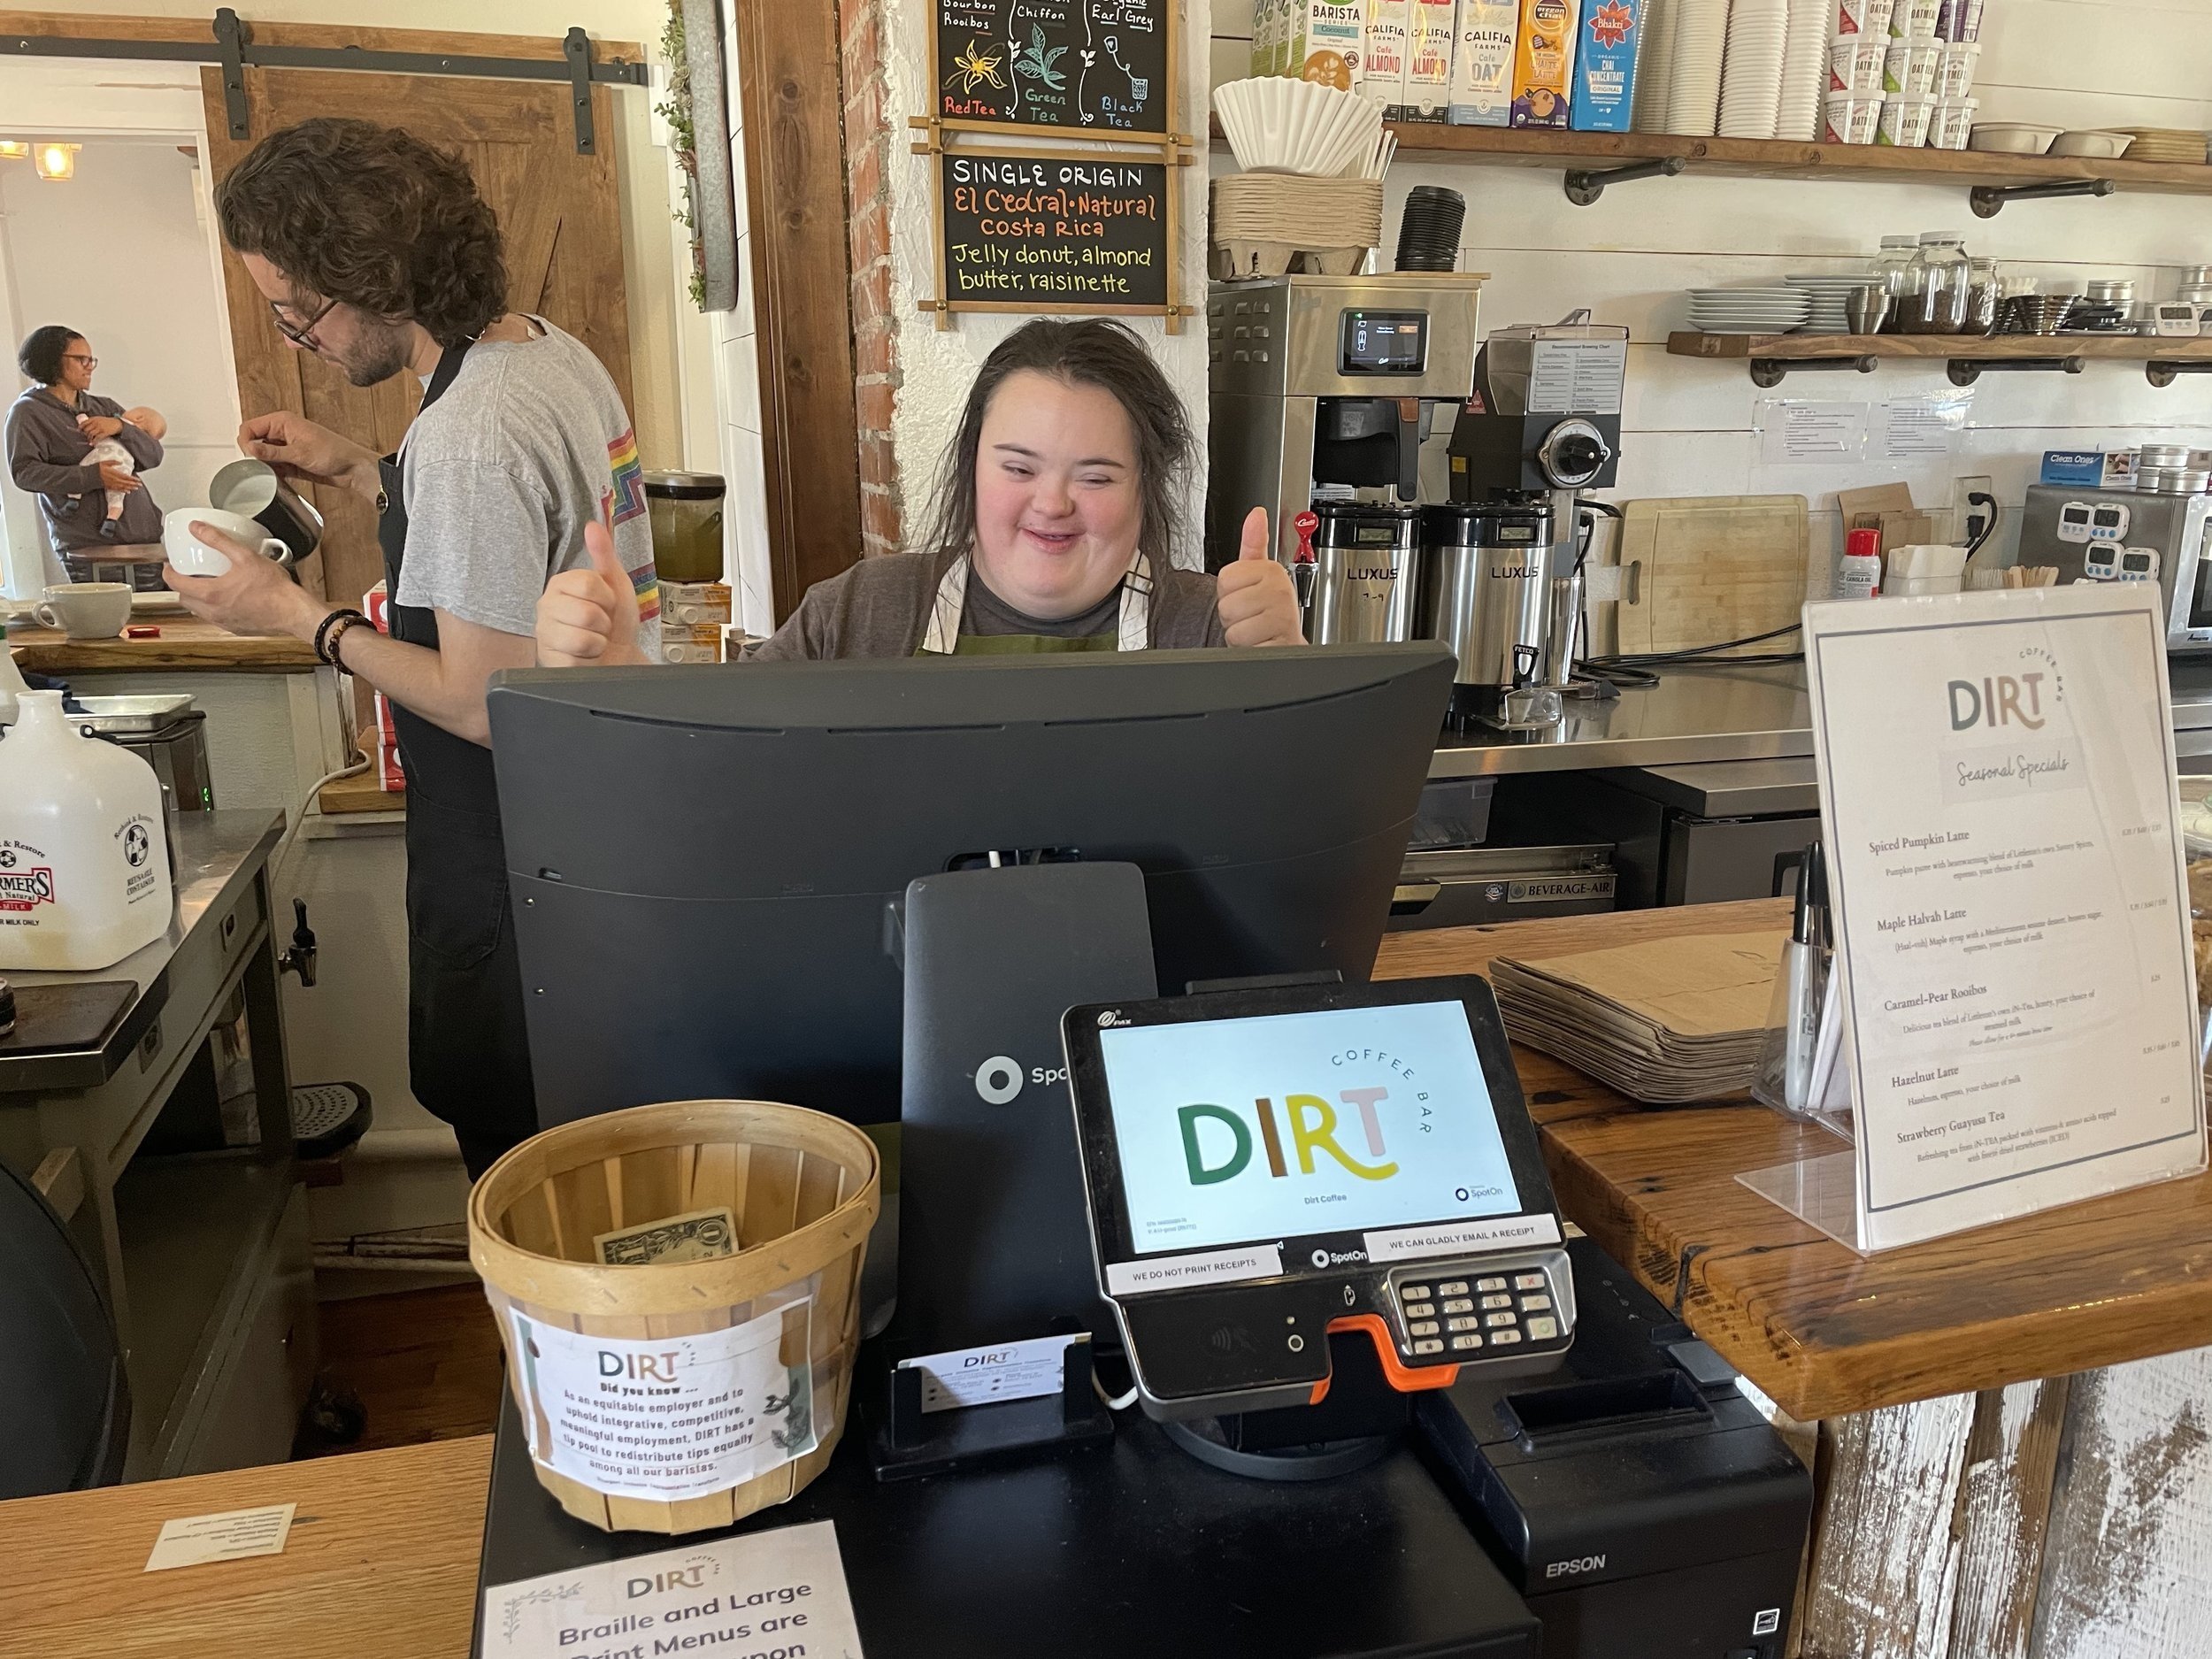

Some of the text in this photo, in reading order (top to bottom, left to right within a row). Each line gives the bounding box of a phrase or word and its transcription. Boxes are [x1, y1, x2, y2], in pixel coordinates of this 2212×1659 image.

[944, 12, 990, 30] Rooibos
[1017, 5, 1065, 20] Chiffon
[1092, 4, 1154, 33] Earl Grey
[1313, 5, 1360, 20] BARISTA
[1365, 25, 1405, 37] CALIFIA
[1464, 31, 1511, 44] CALIFIA
[1365, 54, 1401, 73] ALMOND
[1471, 63, 1502, 81] OAT
[945, 96, 996, 115] Red Tea
[1025, 88, 1066, 105] Green
[1102, 96, 1143, 113] Black
[1030, 107, 1058, 122] Tea
[1106, 113, 1133, 128] Tea
[953, 159, 1142, 188] SINGLE ORIGIN
[954, 187, 979, 214] El
[1056, 219, 1104, 237] Rica
[952, 243, 1152, 266] Jelly donut, almond
[958, 267, 1131, 293] butter, raisinette
[2050, 454, 2095, 465] Clean Ones
[1347, 567, 1398, 580] LUXUS
[1491, 566, 1539, 578] LUXUS
[1514, 646, 1534, 655] FETCO
[1947, 672, 2046, 732] DIRT
[1956, 749, 2070, 787] Seasonal Specials
[14, 841, 46, 859] Restore
[1869, 831, 1970, 856] Spiced Pumpkin Latte
[6, 892, 35, 901] Natural
[1528, 882, 1610, 895] BEVERAGE-AIR
[1877, 909, 1967, 933] Maple Halvah Latte
[1929, 935, 1947, 946] Maple
[1884, 984, 1987, 1011] Caramel-Pear Rooibos
[1902, 1023, 1932, 1034] Delicious
[1331, 1048, 1414, 1080] COFFEE
[1892, 1066, 1959, 1088] Hazelnut Latte
[1417, 1091, 1432, 1134] BAR
[1177, 1085, 1399, 1187] DIRT
[1897, 1110, 2006, 1144] Strawberry Guayusa Tea
[1304, 1193, 1347, 1205] Dirt Coffee
[1471, 1187, 1503, 1198] SpotOn
[1389, 1240, 1404, 1249] WE
[1406, 1239, 1424, 1248] CAN
[1425, 1235, 1460, 1246] GLADLY
[1463, 1232, 1489, 1241] EMAIL
[1500, 1226, 1535, 1238] RECEIPT
[1331, 1249, 1367, 1263] SpotOn
[1133, 1258, 1256, 1281] WE DO NOT PRINT RECEIPTS
[1450, 1284, 1458, 1293] 2
[1417, 1296, 1502, 1315] 4 5 6
[1423, 1323, 1428, 1333] 7
[1499, 1314, 1506, 1324] 9
[1464, 1337, 1472, 1346] 0
[598, 1350, 680, 1383] DIRT
[964, 1351, 1010, 1368] DIRT
[601, 1382, 680, 1396] Did you know
[565, 1388, 743, 1414] As an equitable employer and to
[565, 1406, 744, 1430] uphold integrative, competitive,
[560, 1418, 614, 1441] meaningful
[617, 1434, 691, 1448] employment,
[695, 1426, 720, 1441] DIRT
[725, 1422, 744, 1434] has
[563, 1432, 753, 1462] tip pool to redistribute tips equally
[589, 1459, 623, 1476] among
[626, 1465, 640, 1475] all
[665, 1463, 718, 1477] baristas.
[1546, 1555, 1606, 1578] EPSON
[626, 1564, 705, 1599] DIRT
[559, 1583, 812, 1646] Braille and Large
[654, 1625, 752, 1656] Menus
[761, 1612, 809, 1635] are
